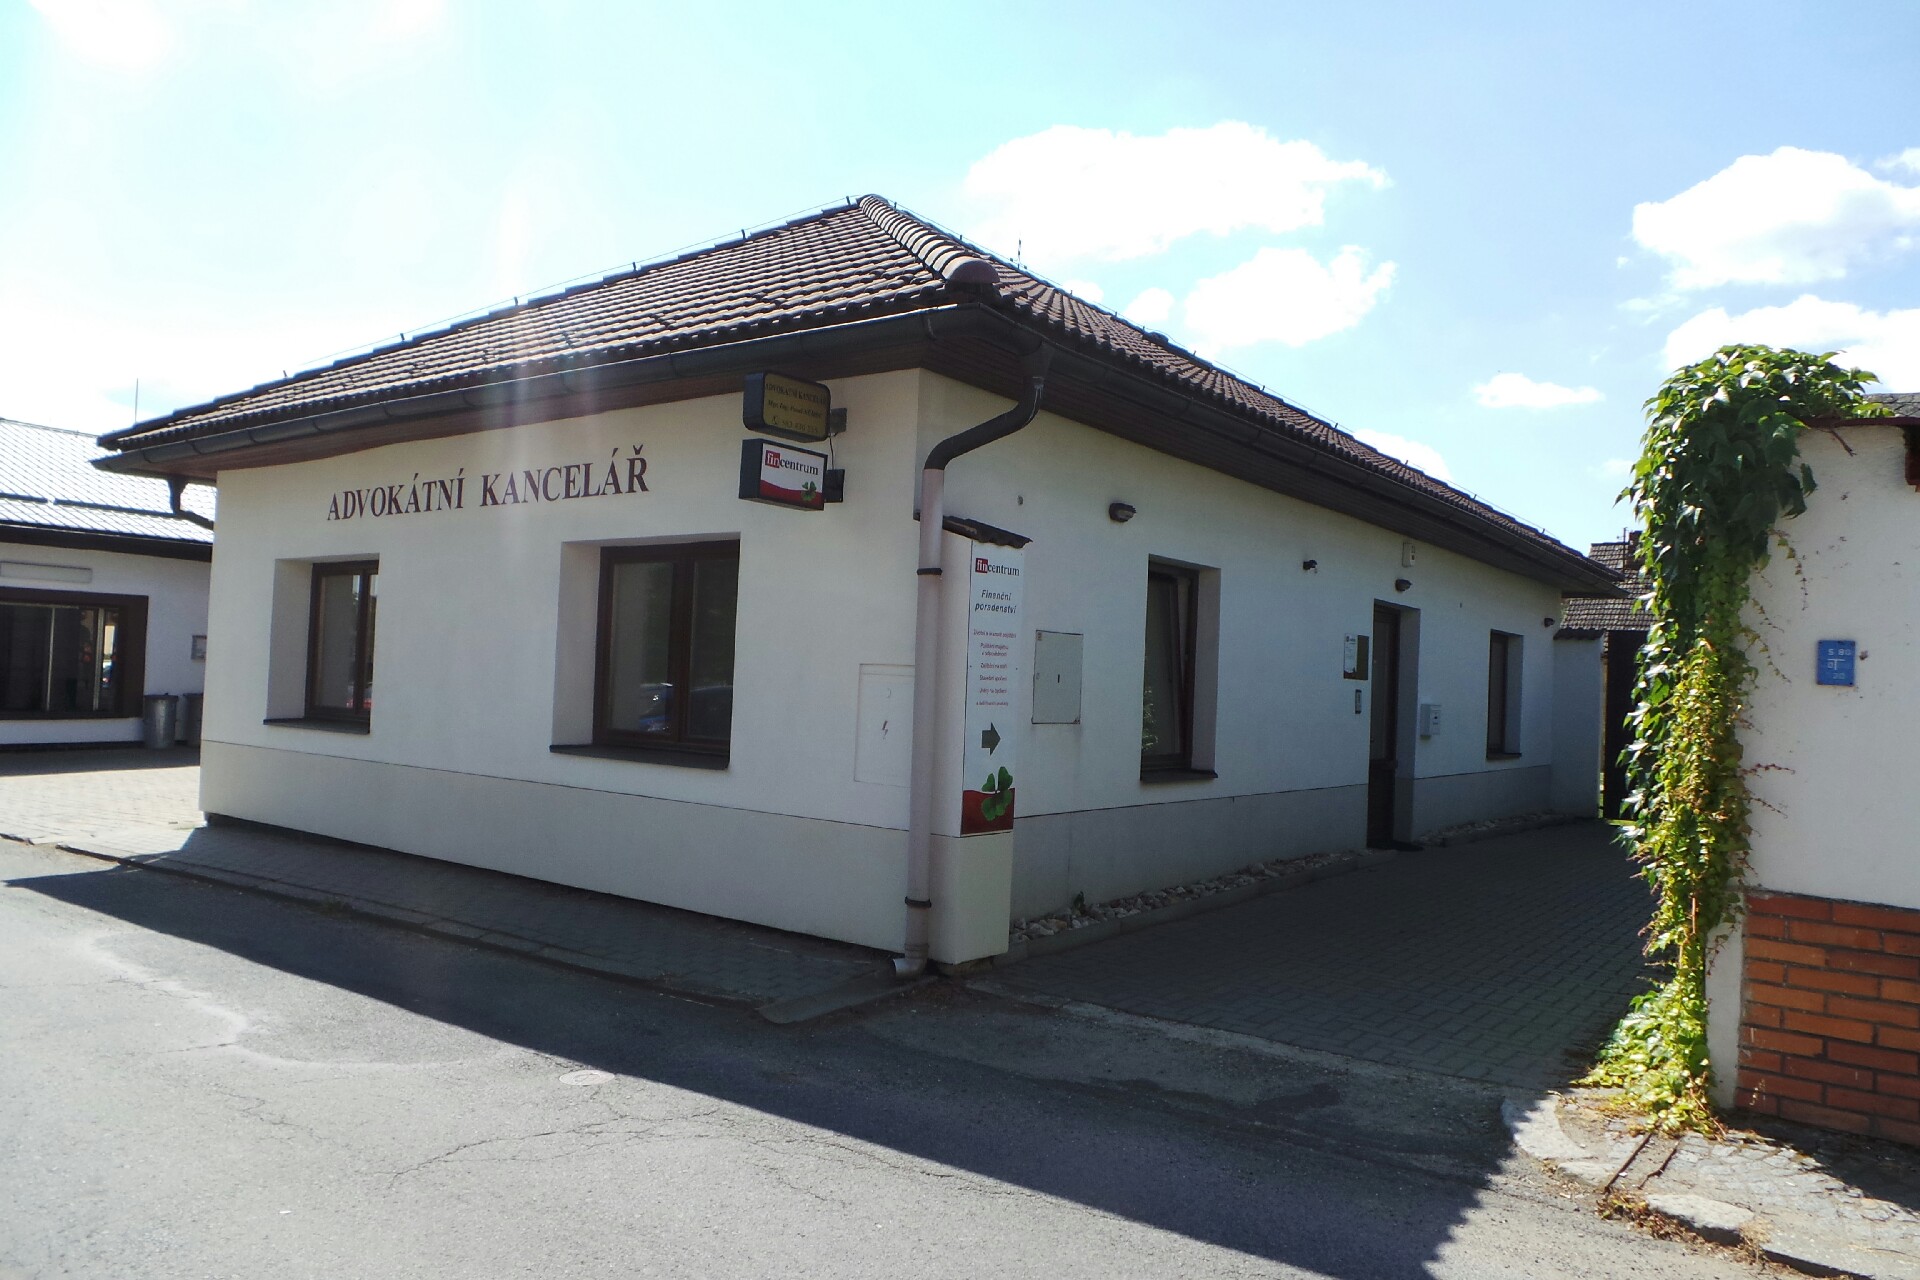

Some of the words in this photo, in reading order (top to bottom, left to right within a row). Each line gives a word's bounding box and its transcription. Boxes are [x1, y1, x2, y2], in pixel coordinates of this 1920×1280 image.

[766, 451, 819, 475] fincentrum
[327, 467, 465, 521] ADVOKÁTNÍ
[480, 444, 650, 507] KANCELÁŘ
[976, 559, 1020, 576] fincentrum
[981, 589, 1012, 601] Finanční
